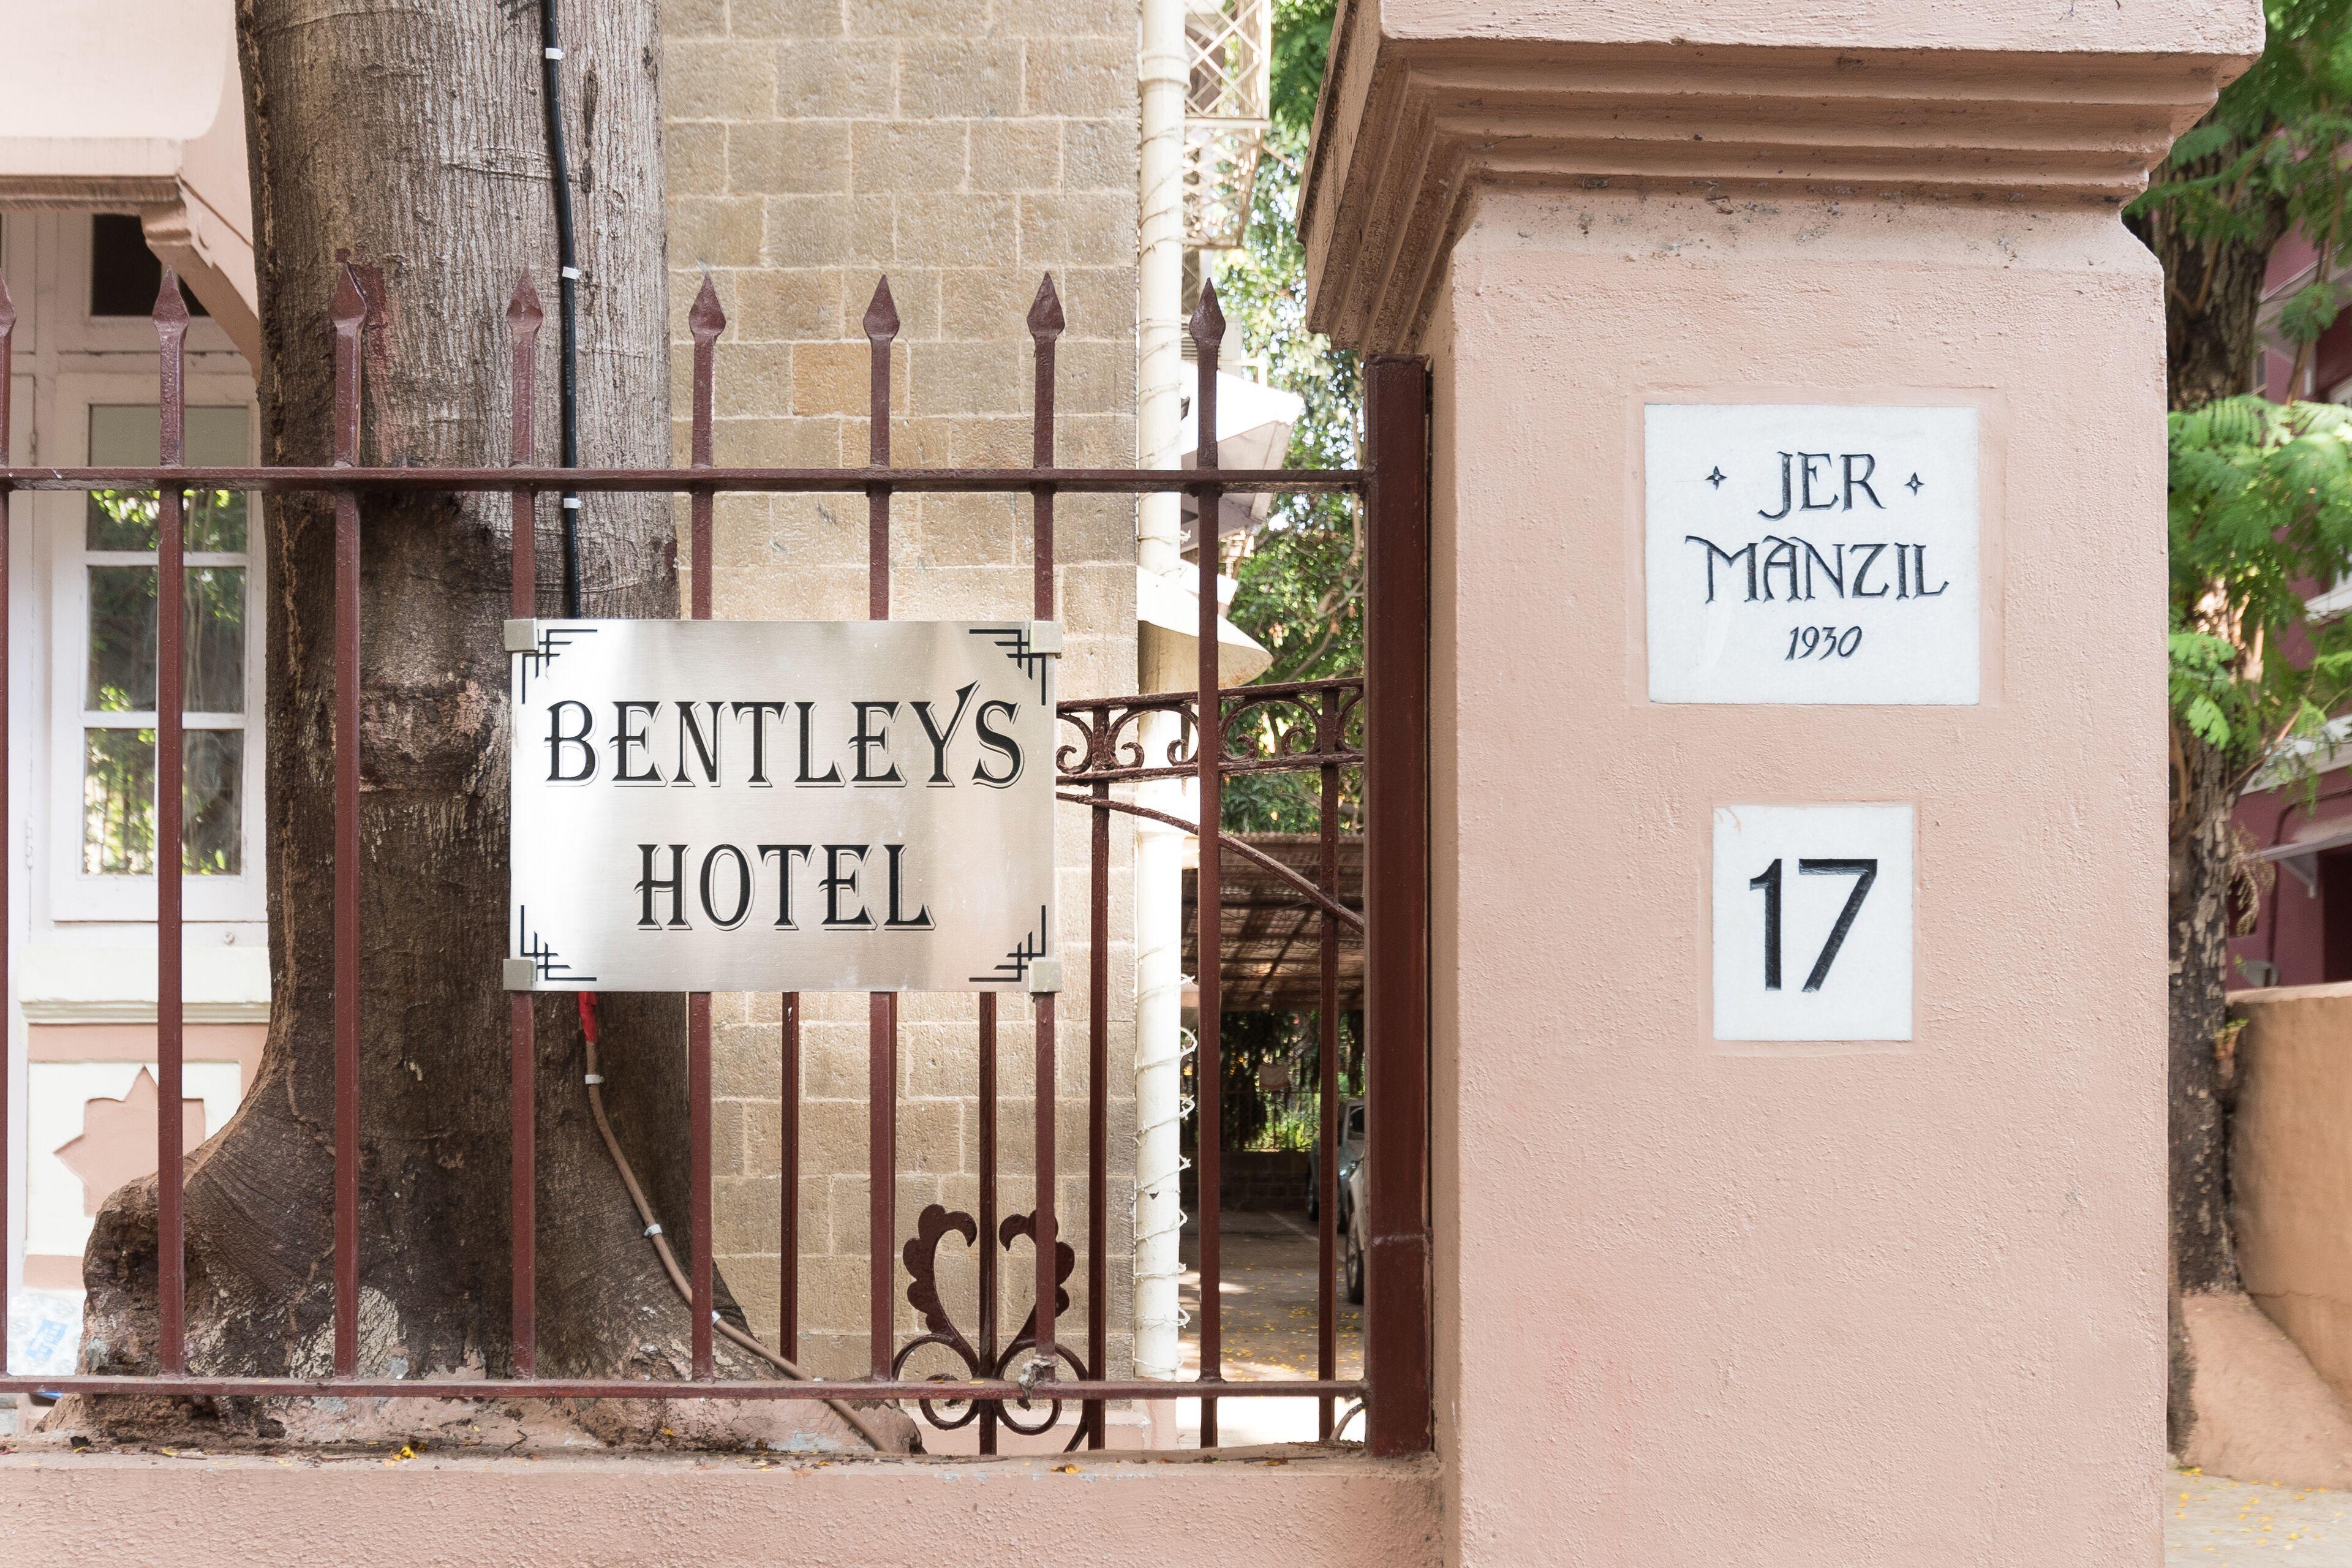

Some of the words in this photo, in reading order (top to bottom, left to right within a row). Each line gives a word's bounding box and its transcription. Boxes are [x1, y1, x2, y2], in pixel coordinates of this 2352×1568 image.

[1758, 451, 1886, 521] JER
[1685, 534, 1950, 604] MANZIL
[1784, 625, 1862, 661] 1930
[635, 845, 936, 931] HOTEL
[1750, 859, 1878, 992] 17
